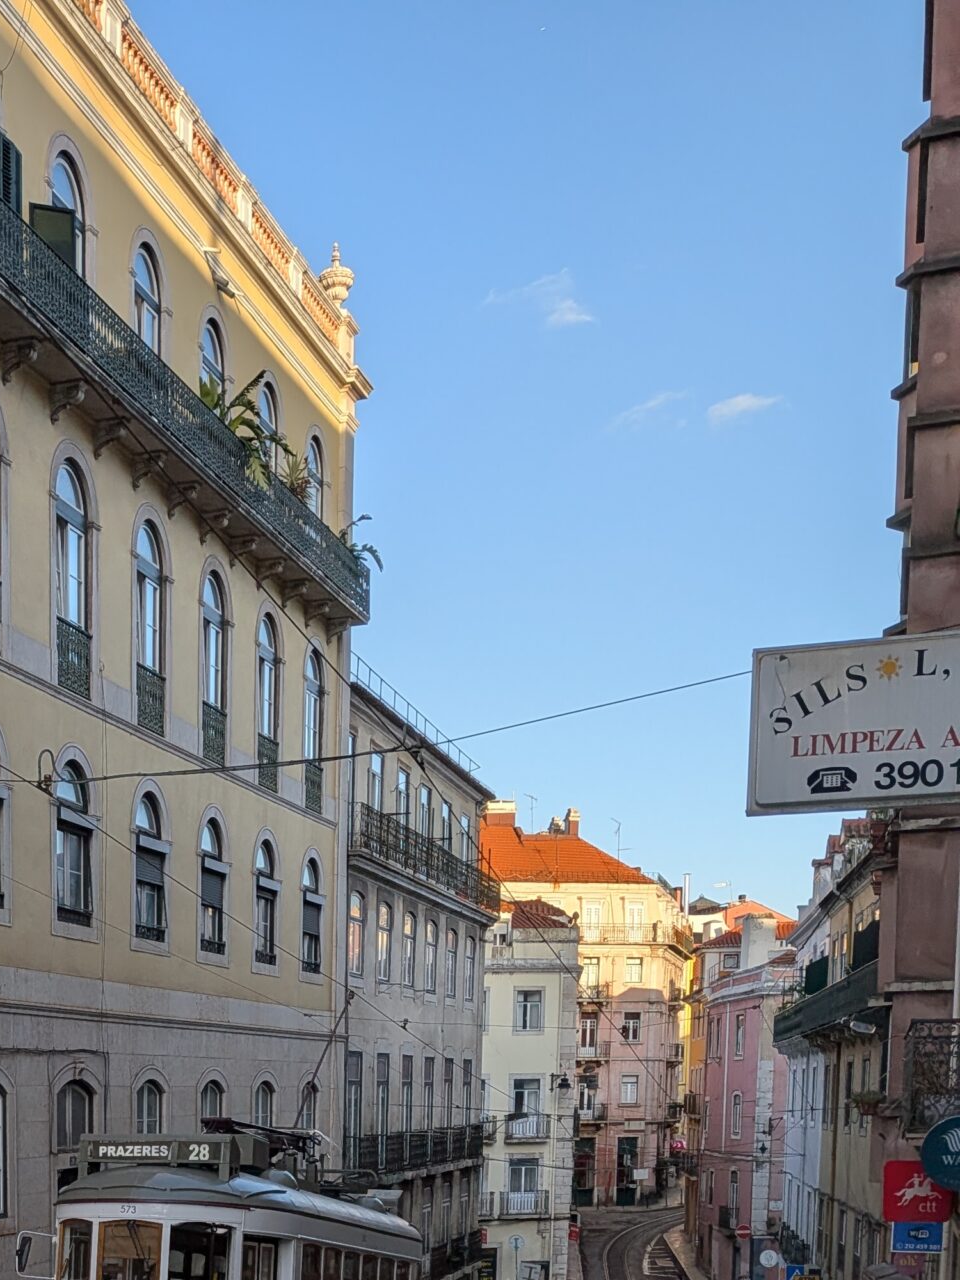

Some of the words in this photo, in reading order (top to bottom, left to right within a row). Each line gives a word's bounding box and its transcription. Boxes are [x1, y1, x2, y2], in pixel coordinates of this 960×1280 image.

[791, 728, 926, 758] LIMPEZA
[98, 1145, 169, 1158] PRAZERES
[188, 1143, 210, 1161] 28
[119, 1205, 137, 1214] 573
